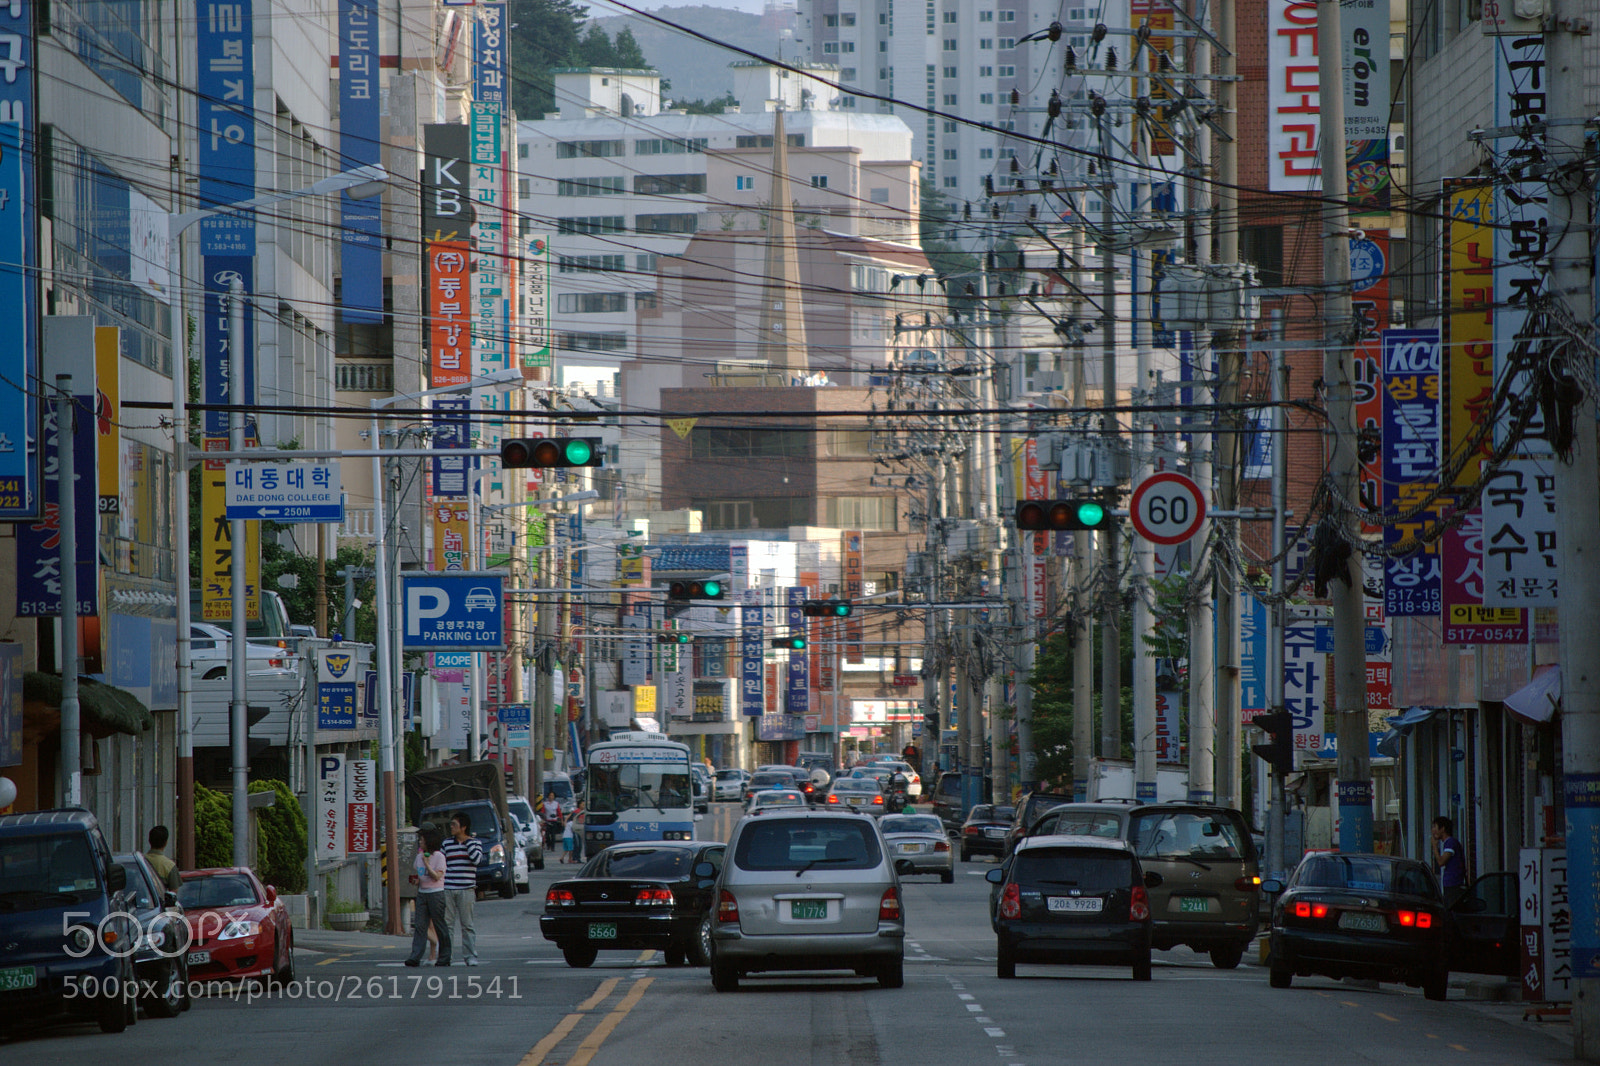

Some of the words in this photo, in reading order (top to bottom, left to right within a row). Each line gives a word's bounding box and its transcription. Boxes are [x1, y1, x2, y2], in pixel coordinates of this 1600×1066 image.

[349, 4, 370, 99] 신도리코
[482, 7, 503, 89] 명성치과
[1353, 27, 1377, 107] erom
[435, 158, 461, 216] KB
[476, 166, 497, 203] 치과
[434, 252, 465, 273] (주)
[236, 494, 255, 502] DAE
[258, 494, 284, 502] DONG
[287, 493, 331, 502] COLLEGE
[284, 507, 311, 516] 250M
[1149, 496, 1189, 525] 60
[21, 602, 92, 614] 513-945
[407, 586, 450, 636] P
[1454, 608, 1519, 623] 이벤트
[436, 620, 485, 630] 공영주차장
[424, 631, 471, 641] PARKING
[476, 631, 497, 641] LOT
[1447, 629, 1524, 646] 517-0547
[438, 655, 472, 666] 24OPE
[600, 751, 617, 763] 29-1
[321, 757, 340, 780] P
[1524, 859, 1539, 918] 가야
[803, 906, 825, 917] 1776
[1074, 900, 1098, 910] 9928
[1187, 901, 1207, 912] 2441
[1355, 917, 1379, 929] 7639
[590, 927, 617, 938] 5560
[6, 974, 34, 989] 3670
